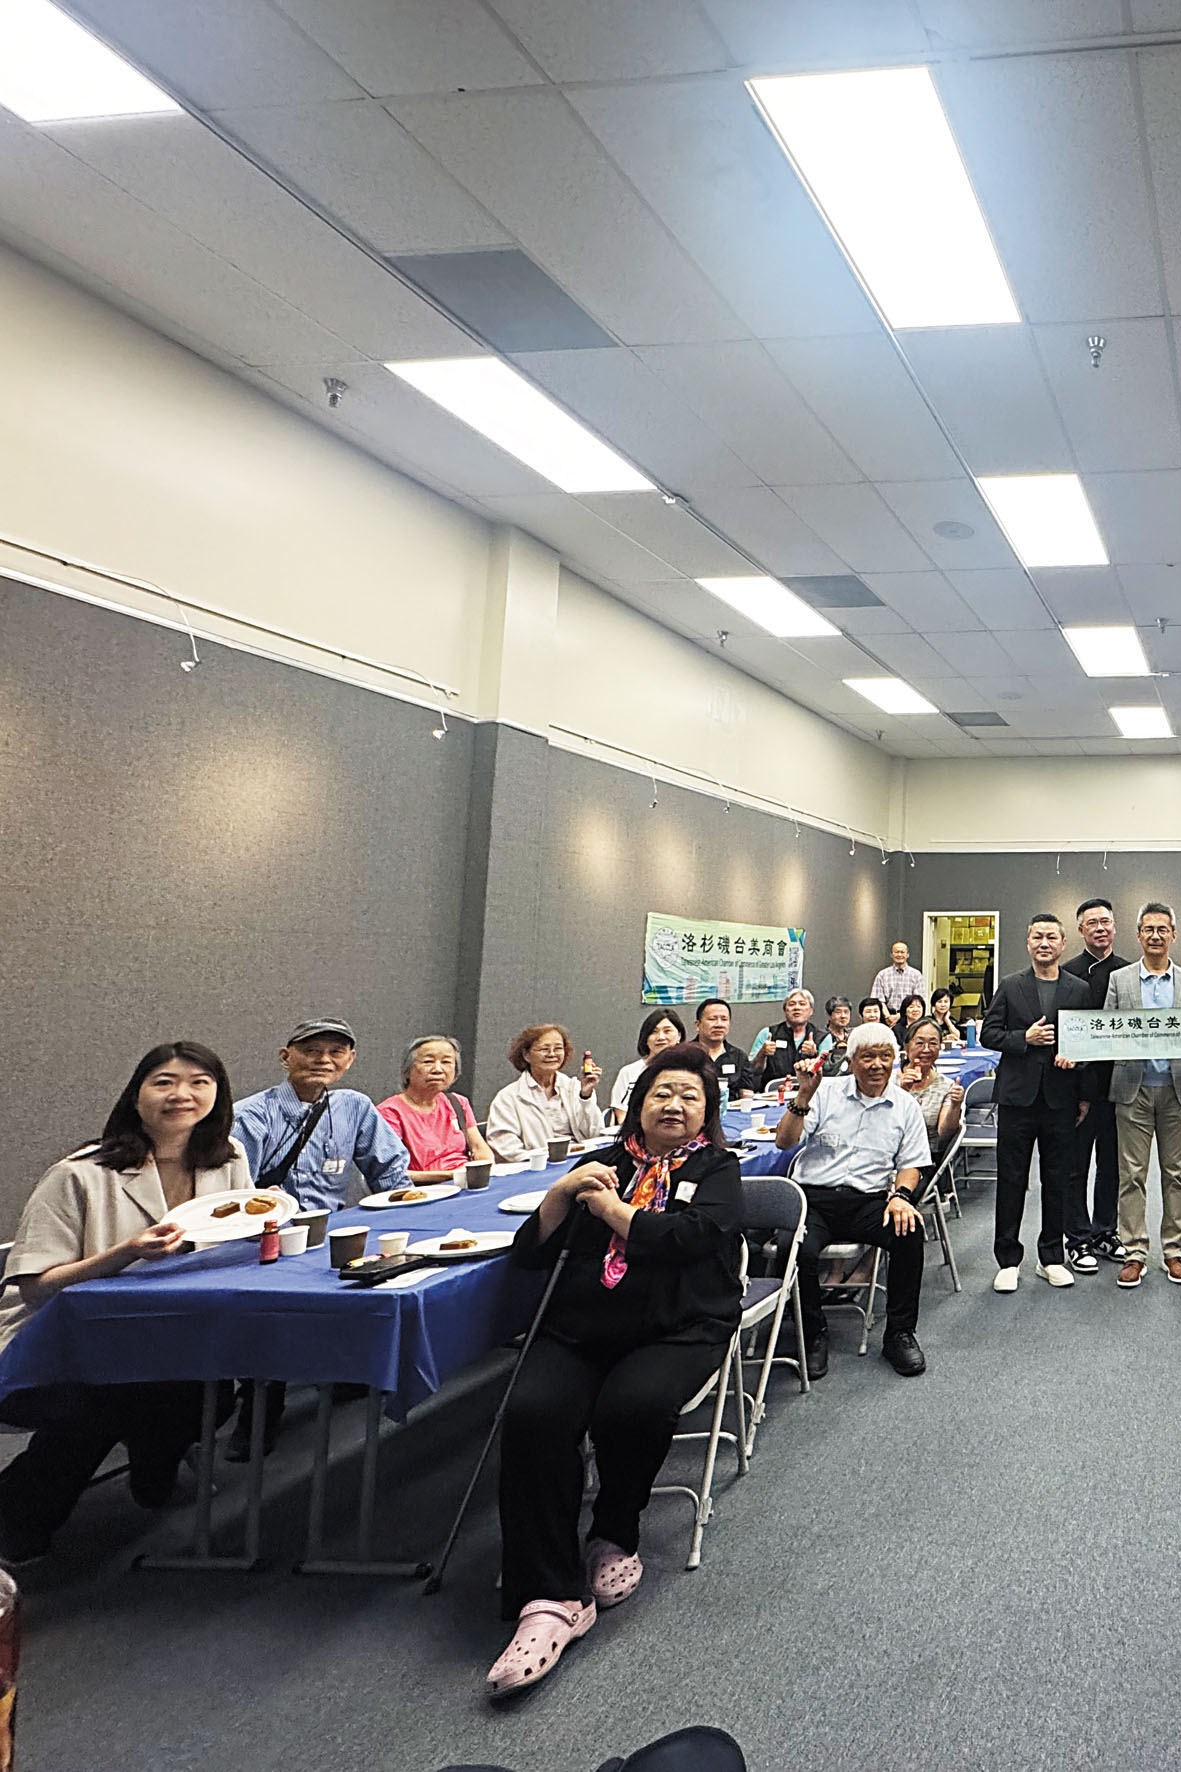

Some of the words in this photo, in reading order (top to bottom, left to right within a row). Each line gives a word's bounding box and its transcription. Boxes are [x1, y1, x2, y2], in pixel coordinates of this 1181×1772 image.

[681, 933, 788, 956] 洛杉磯台美商會
